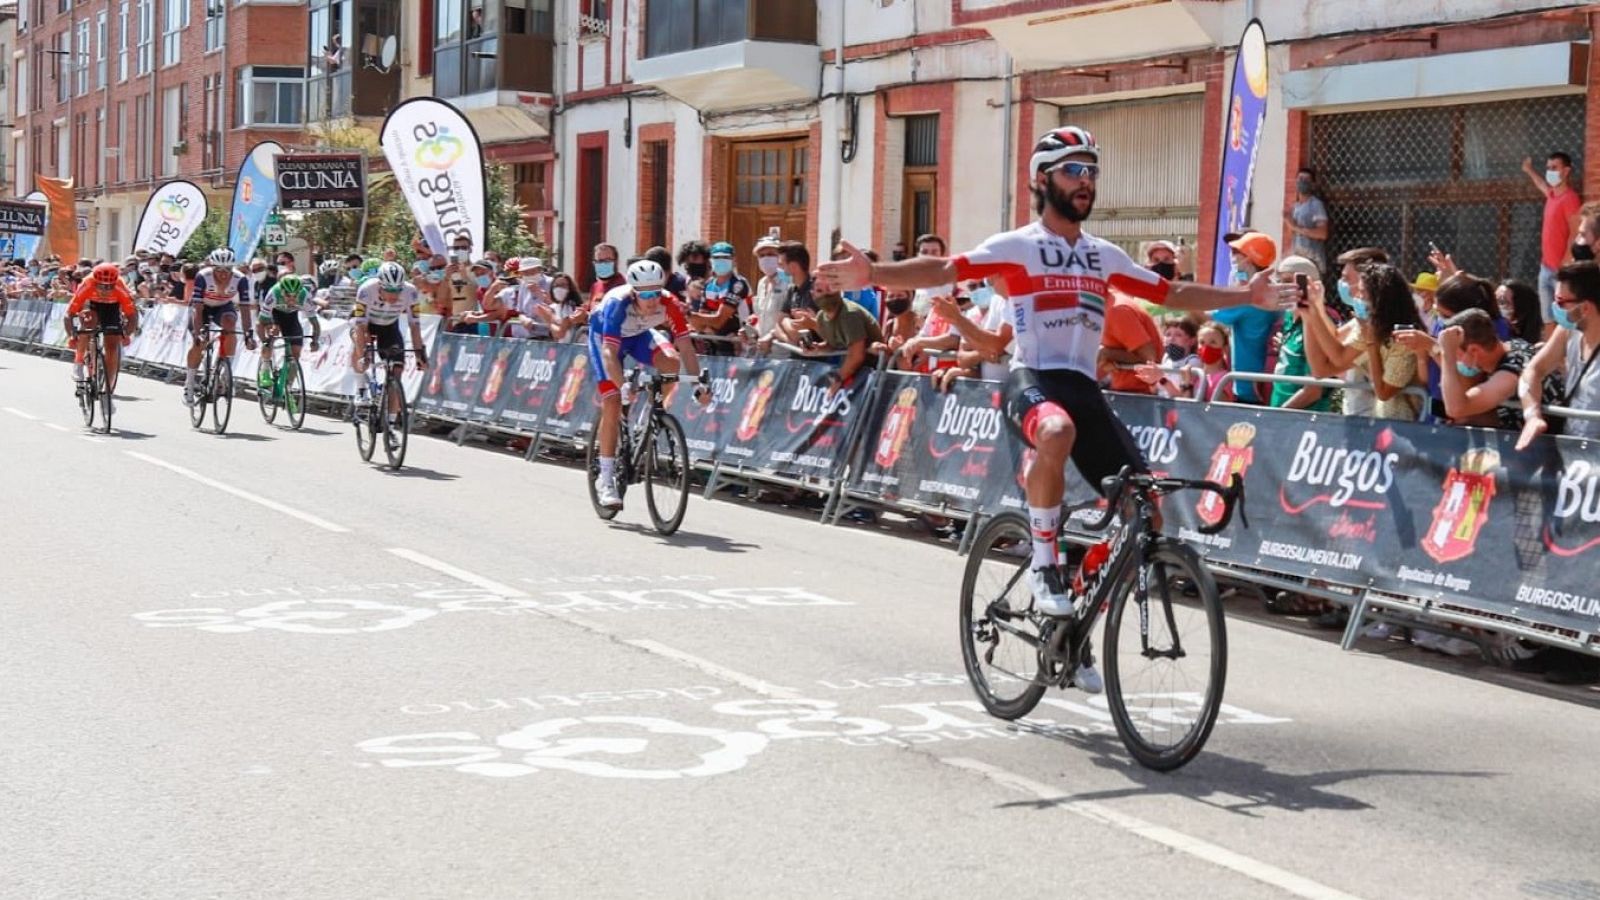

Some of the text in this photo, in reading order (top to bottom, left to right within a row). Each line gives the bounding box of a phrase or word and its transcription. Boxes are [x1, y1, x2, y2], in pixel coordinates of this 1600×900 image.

[279, 170, 359, 190] CLUNIA
[291, 199, 350, 208] 25 mts.
[149, 194, 191, 254] urgos
[269, 233, 284, 242] 24
[1040, 248, 1102, 272] UAE
[517, 350, 556, 390] Burgos
[936, 393, 1002, 452] Burgos
[1287, 430, 1400, 507] Burgos
[1259, 540, 1362, 571] BURGOSALIMENTA.COM
